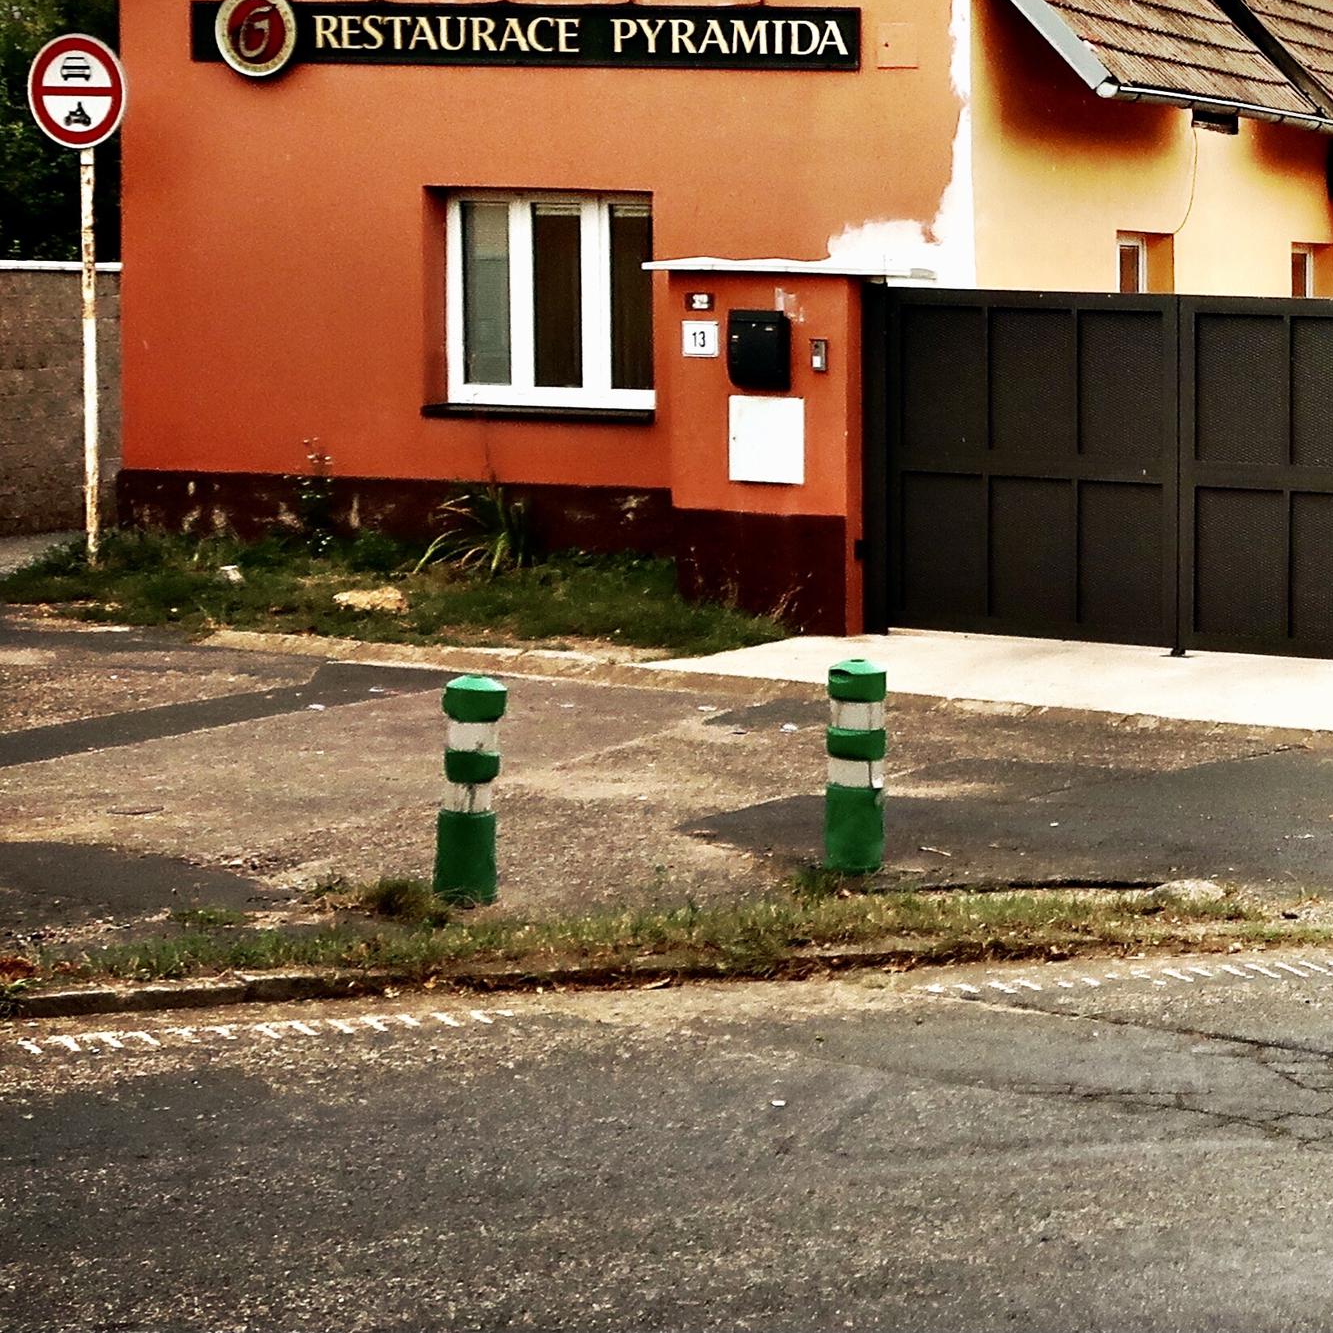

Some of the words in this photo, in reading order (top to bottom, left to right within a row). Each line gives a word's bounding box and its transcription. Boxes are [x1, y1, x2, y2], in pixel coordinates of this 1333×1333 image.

[312, 15, 581, 53] RESTAURACE
[612, 18, 849, 56] PYRAMIDA
[692, 330, 706, 348] 13
